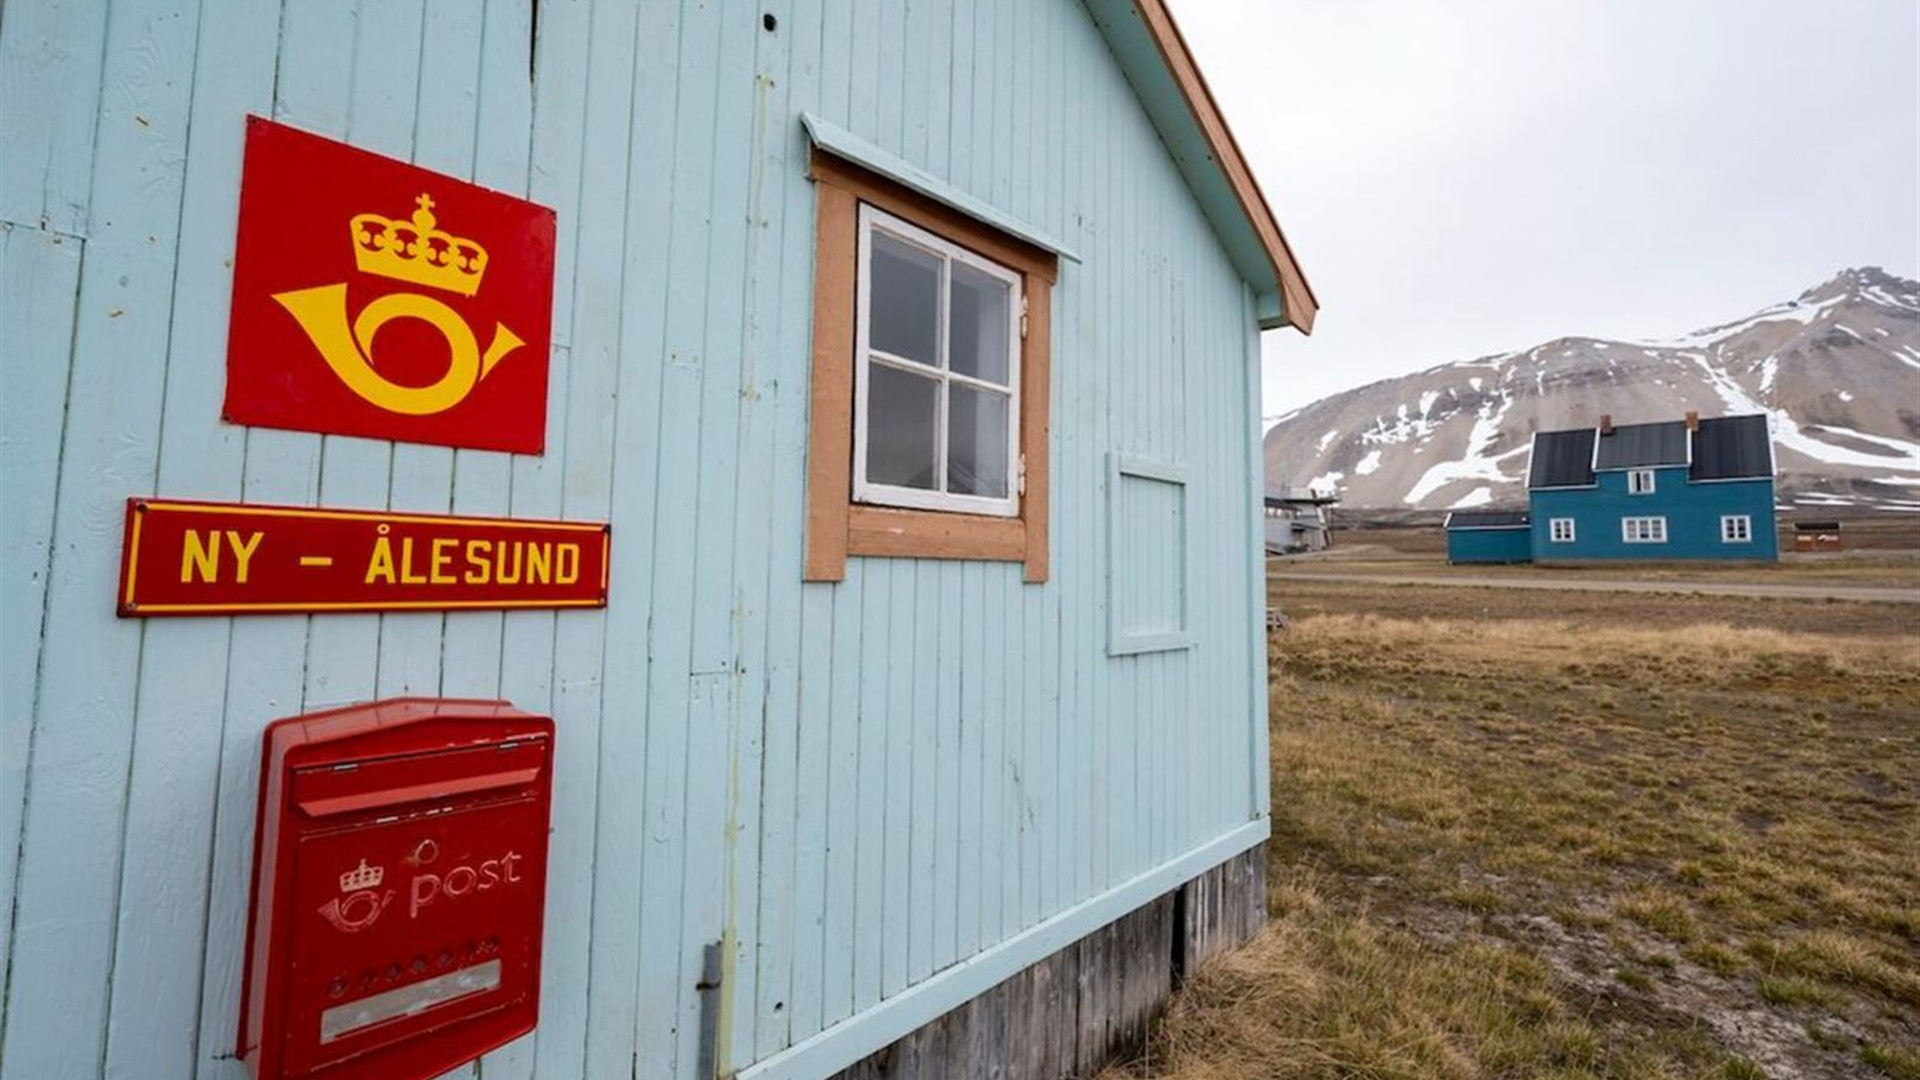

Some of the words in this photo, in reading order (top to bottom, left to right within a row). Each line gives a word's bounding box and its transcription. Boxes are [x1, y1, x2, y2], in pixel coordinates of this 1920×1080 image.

[181, 529, 264, 583] NY
[364, 523, 580, 584] ÅLESUND
[409, 850, 522, 919] post
